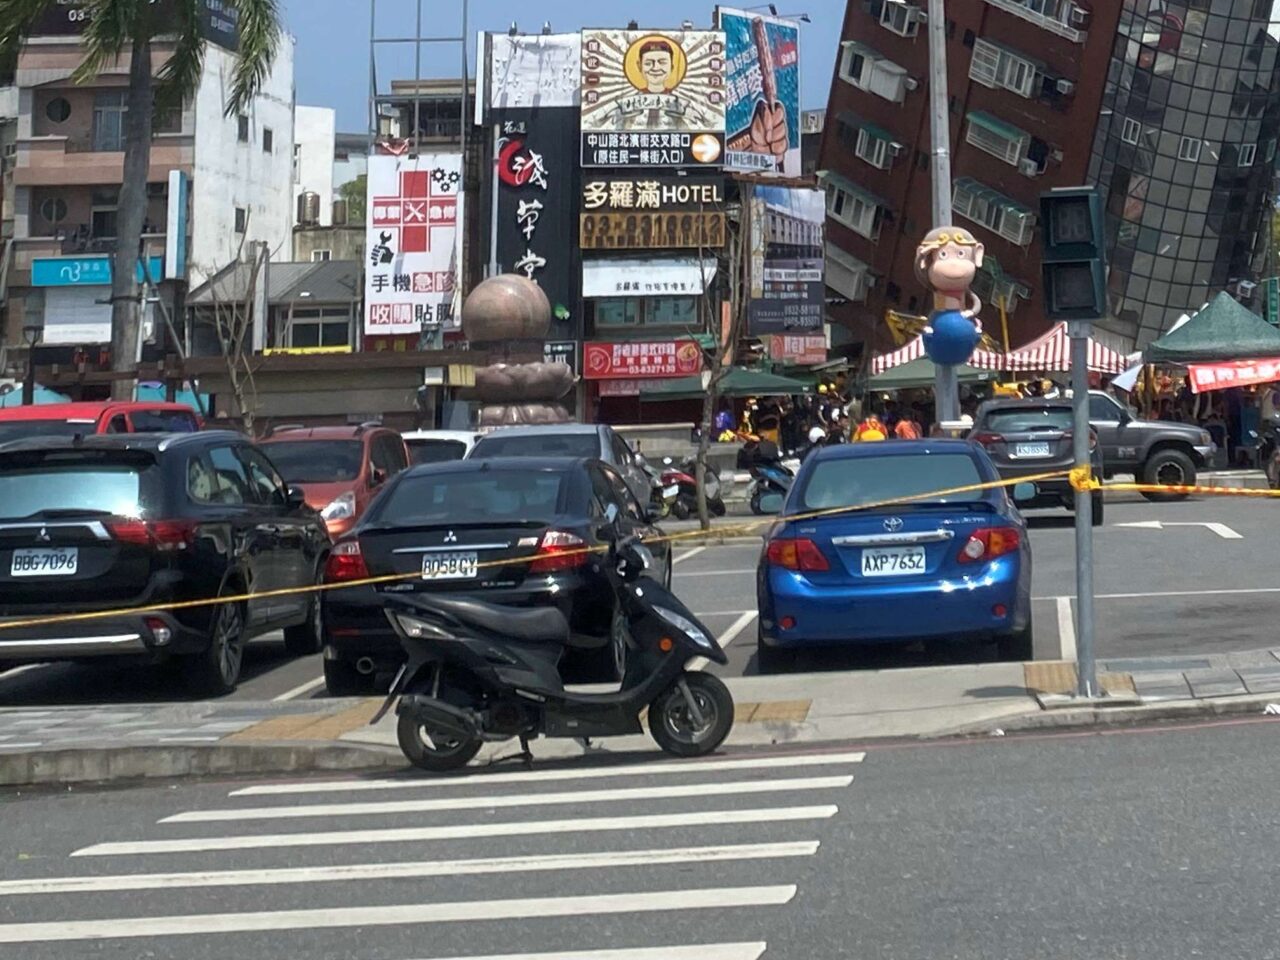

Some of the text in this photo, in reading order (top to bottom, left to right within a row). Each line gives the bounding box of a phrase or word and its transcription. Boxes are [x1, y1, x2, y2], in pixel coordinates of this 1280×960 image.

[587, 134, 691, 148] 中山路北濱街交叉路口
[371, 271, 455, 293] 手機急診
